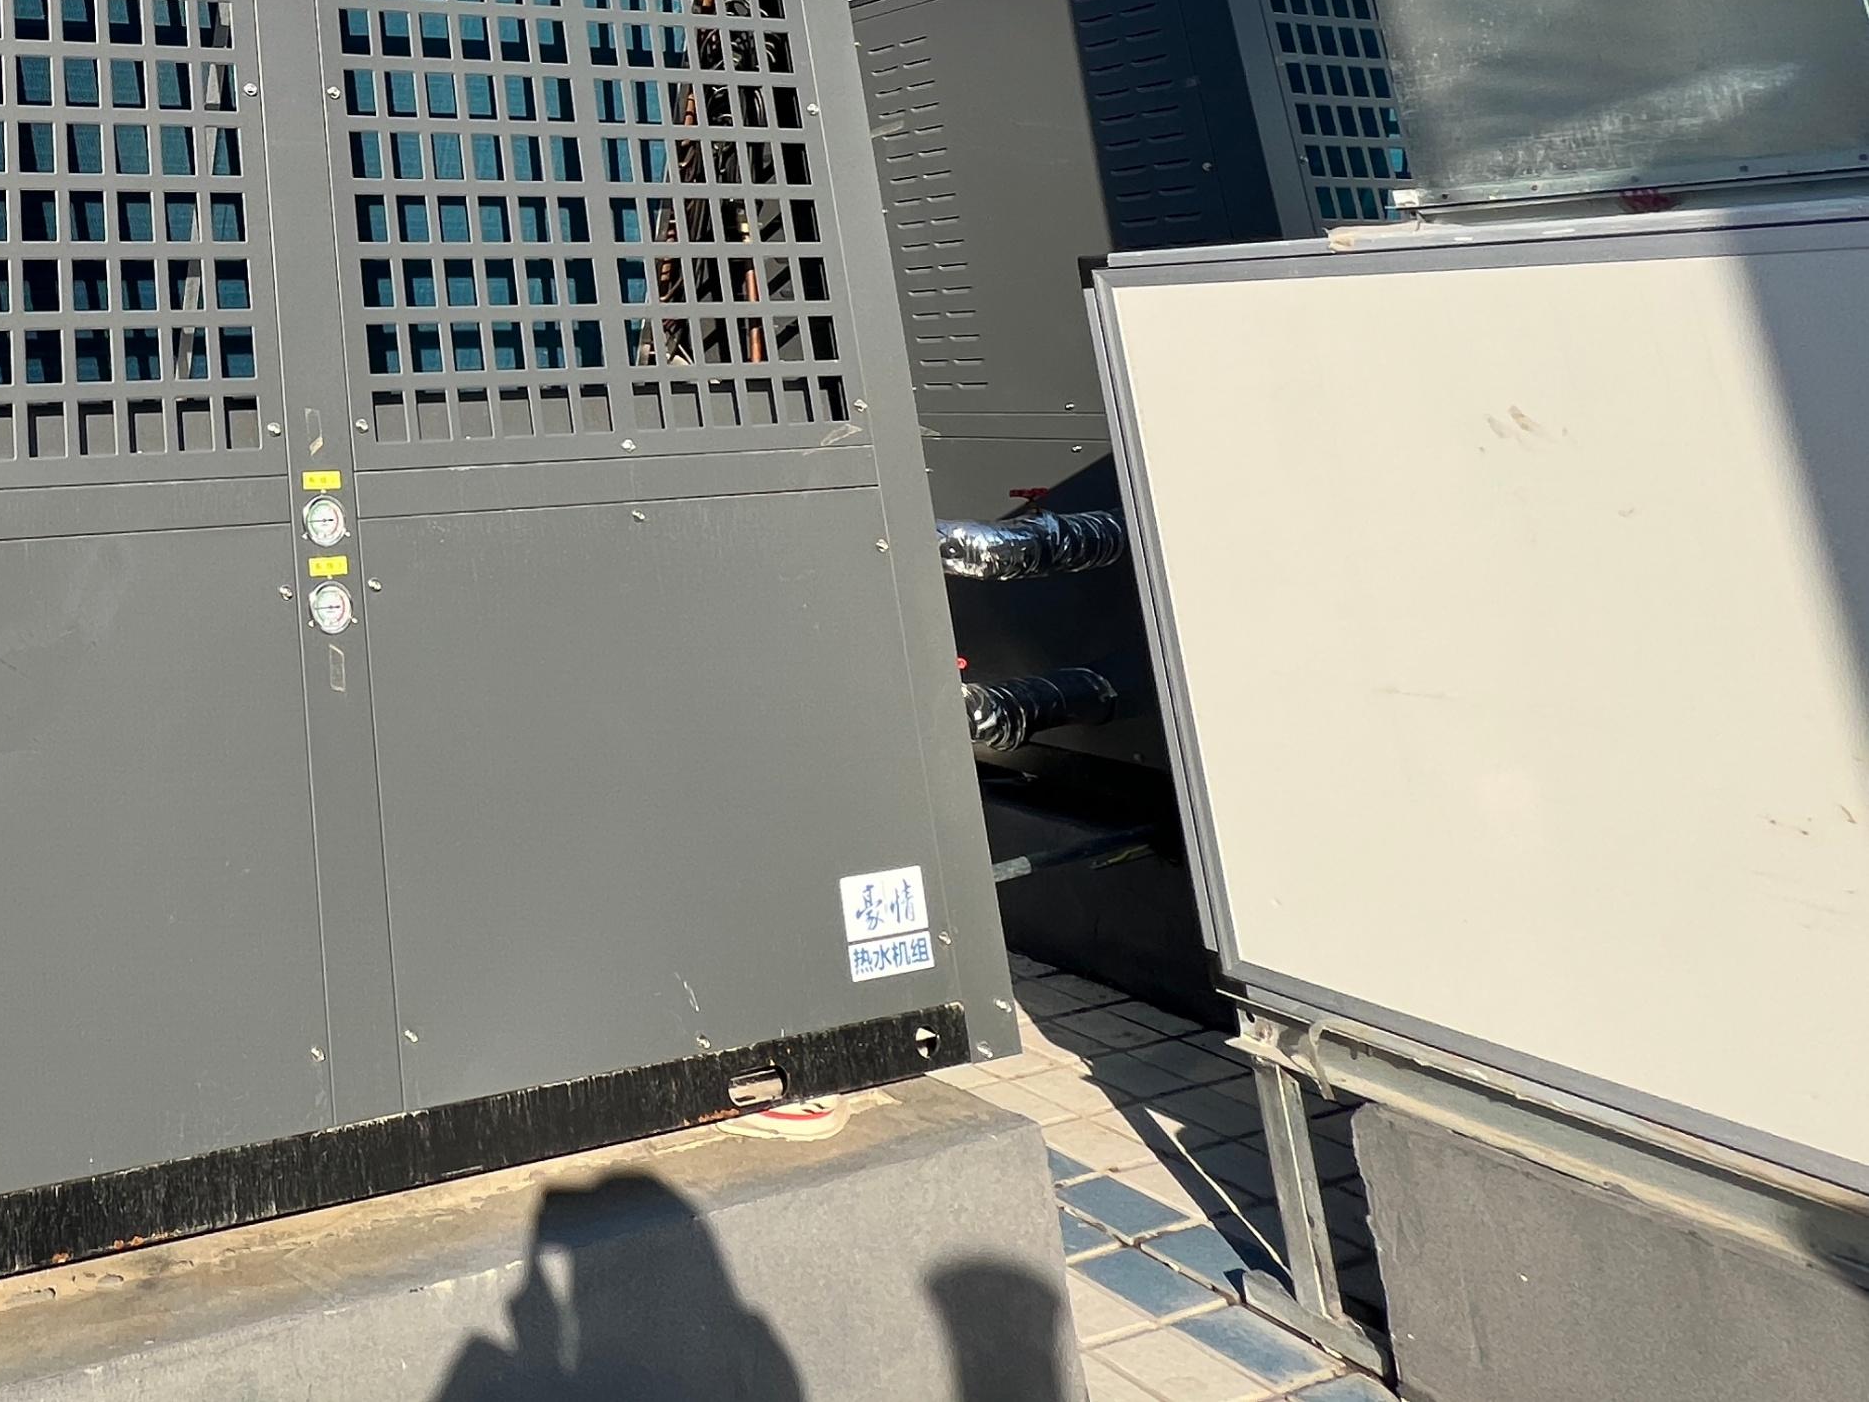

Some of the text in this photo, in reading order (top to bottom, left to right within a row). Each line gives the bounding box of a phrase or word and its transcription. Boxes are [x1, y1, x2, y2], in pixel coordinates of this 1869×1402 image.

[855, 878, 915, 931] 豪情
[853, 937, 930, 975] 热水机组
